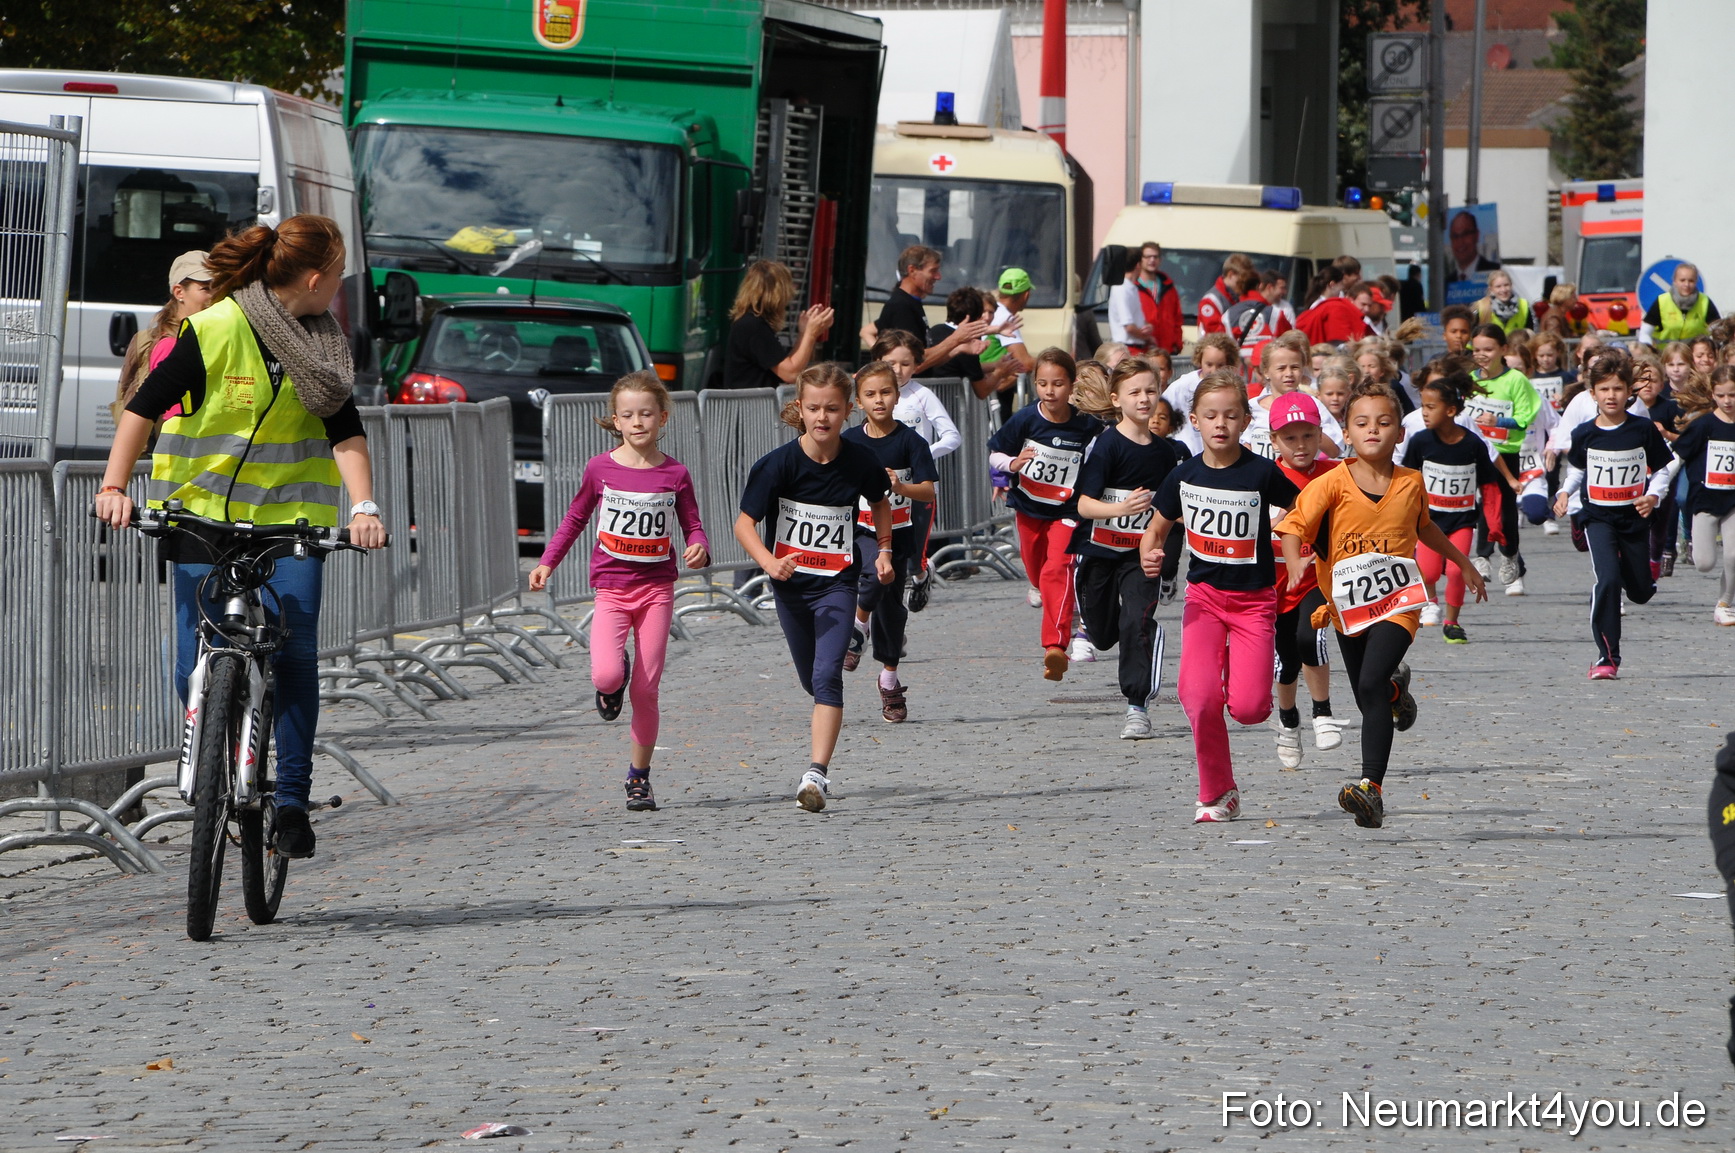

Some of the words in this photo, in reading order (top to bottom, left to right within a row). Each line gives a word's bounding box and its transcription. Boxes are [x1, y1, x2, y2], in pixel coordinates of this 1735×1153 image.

[1041, 451, 1071, 463] Neumarkt
[1589, 454, 1607, 462] PARTL
[1608, 455, 1638, 463] Neumarkt
[1024, 457, 1070, 485] 7331
[1593, 463, 1640, 486] 7172
[1428, 474, 1471, 495] 7157
[1181, 489, 1205, 502] PARTL
[1206, 496, 1247, 507] Neumarkt
[1602, 489, 1632, 499] Leonie
[628, 499, 665, 508] Neumarkt
[780, 503, 804, 518] PARTL
[805, 511, 843, 521] Neumarkt
[607, 507, 666, 537] 7209
[1187, 503, 1250, 538] 7200
[785, 516, 845, 550] 7024
[614, 538, 657, 554] Theresa
[1203, 540, 1225, 554] Mia
[1343, 539, 1393, 554] OEXL
[796, 555, 827, 567] Lucia
[1334, 567, 1356, 579] PARTL
[1342, 562, 1410, 606] 7250
[1368, 597, 1400, 619] Alicia
